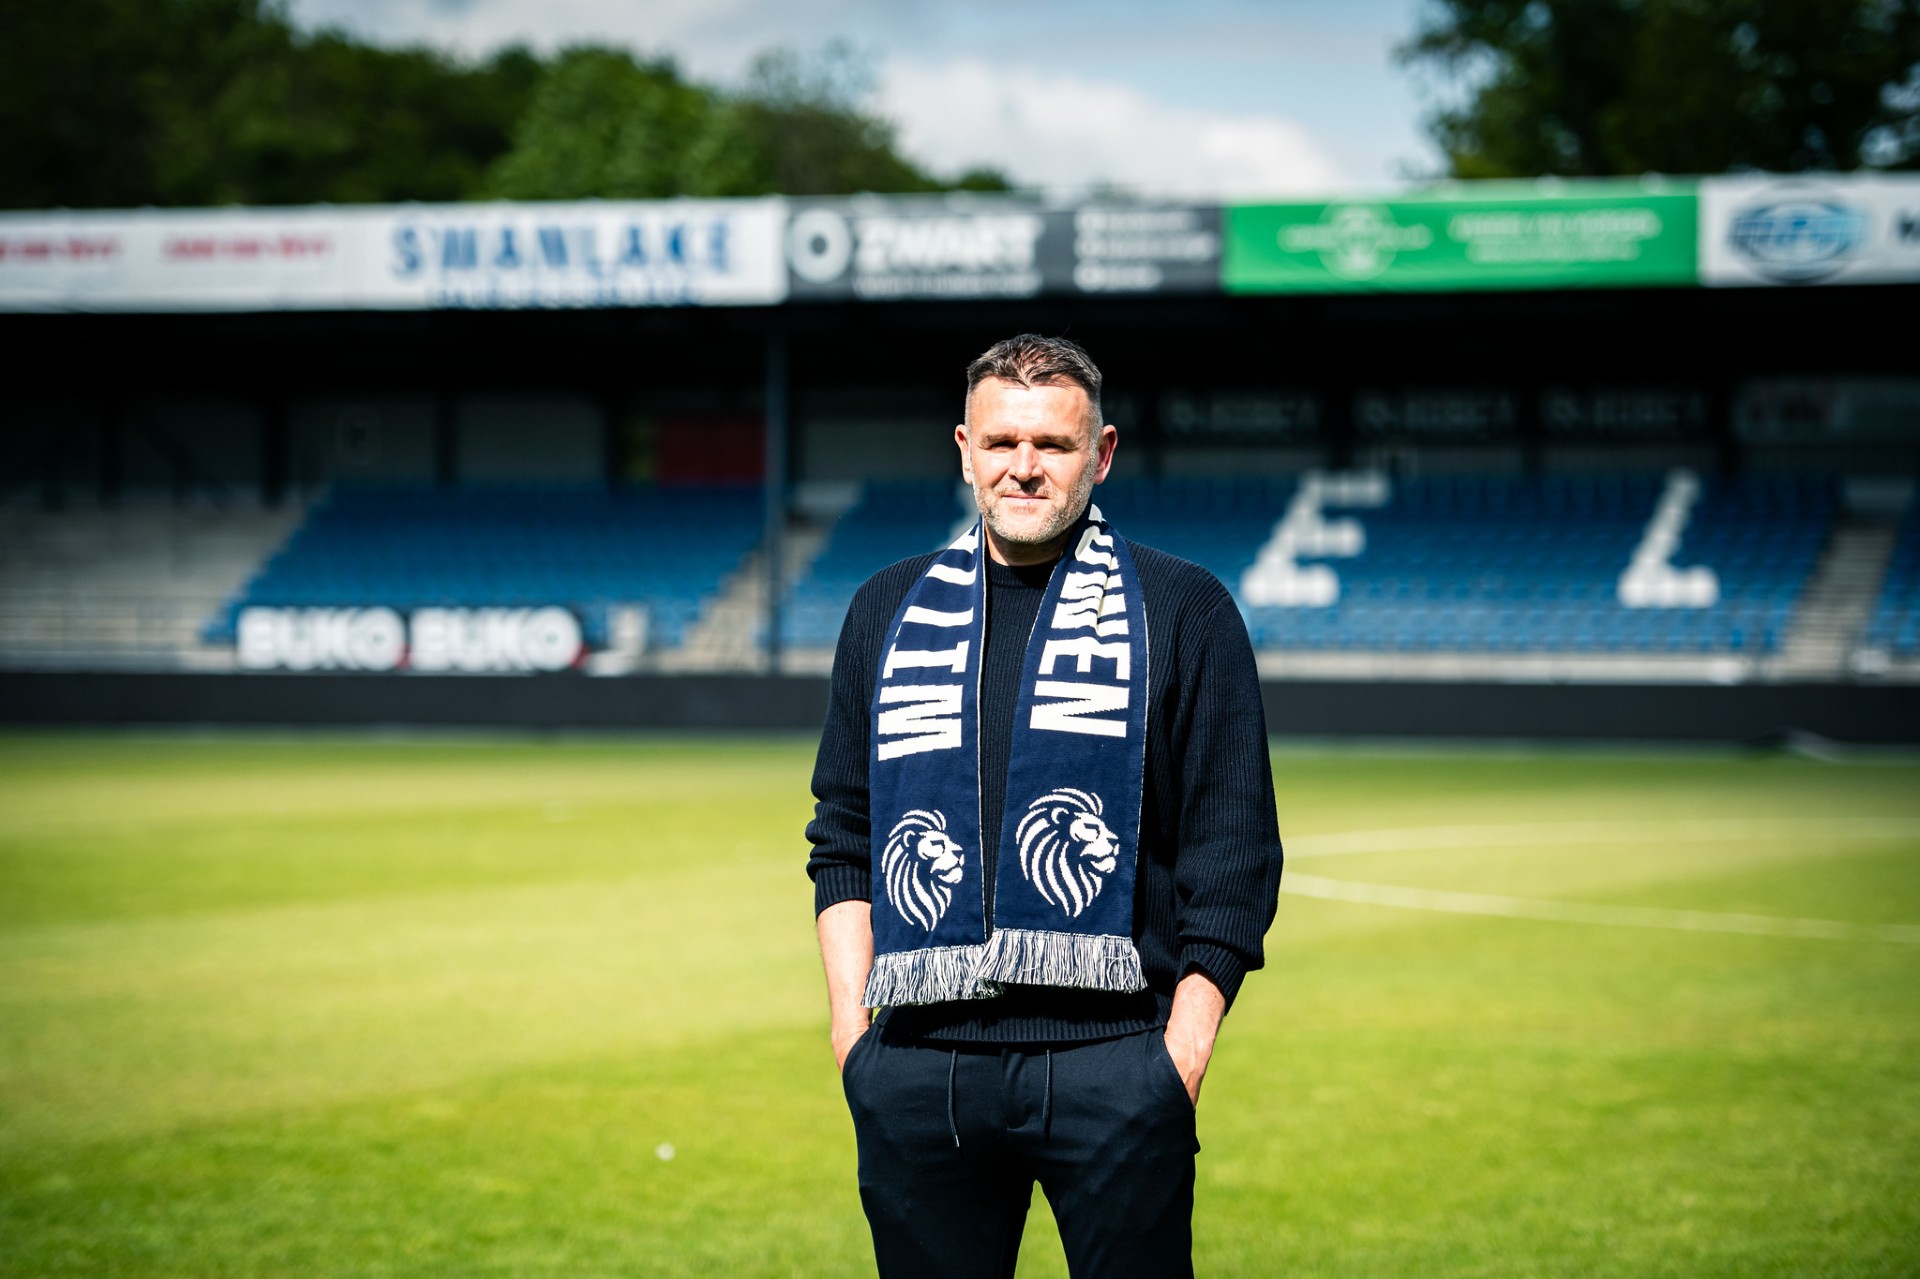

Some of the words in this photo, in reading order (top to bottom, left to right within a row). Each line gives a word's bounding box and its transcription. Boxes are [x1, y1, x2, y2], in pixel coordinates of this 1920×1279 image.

[390, 215, 731, 281] SWANLAKE
[237, 604, 406, 672] BUKO
[410, 604, 583, 672] BUKO
